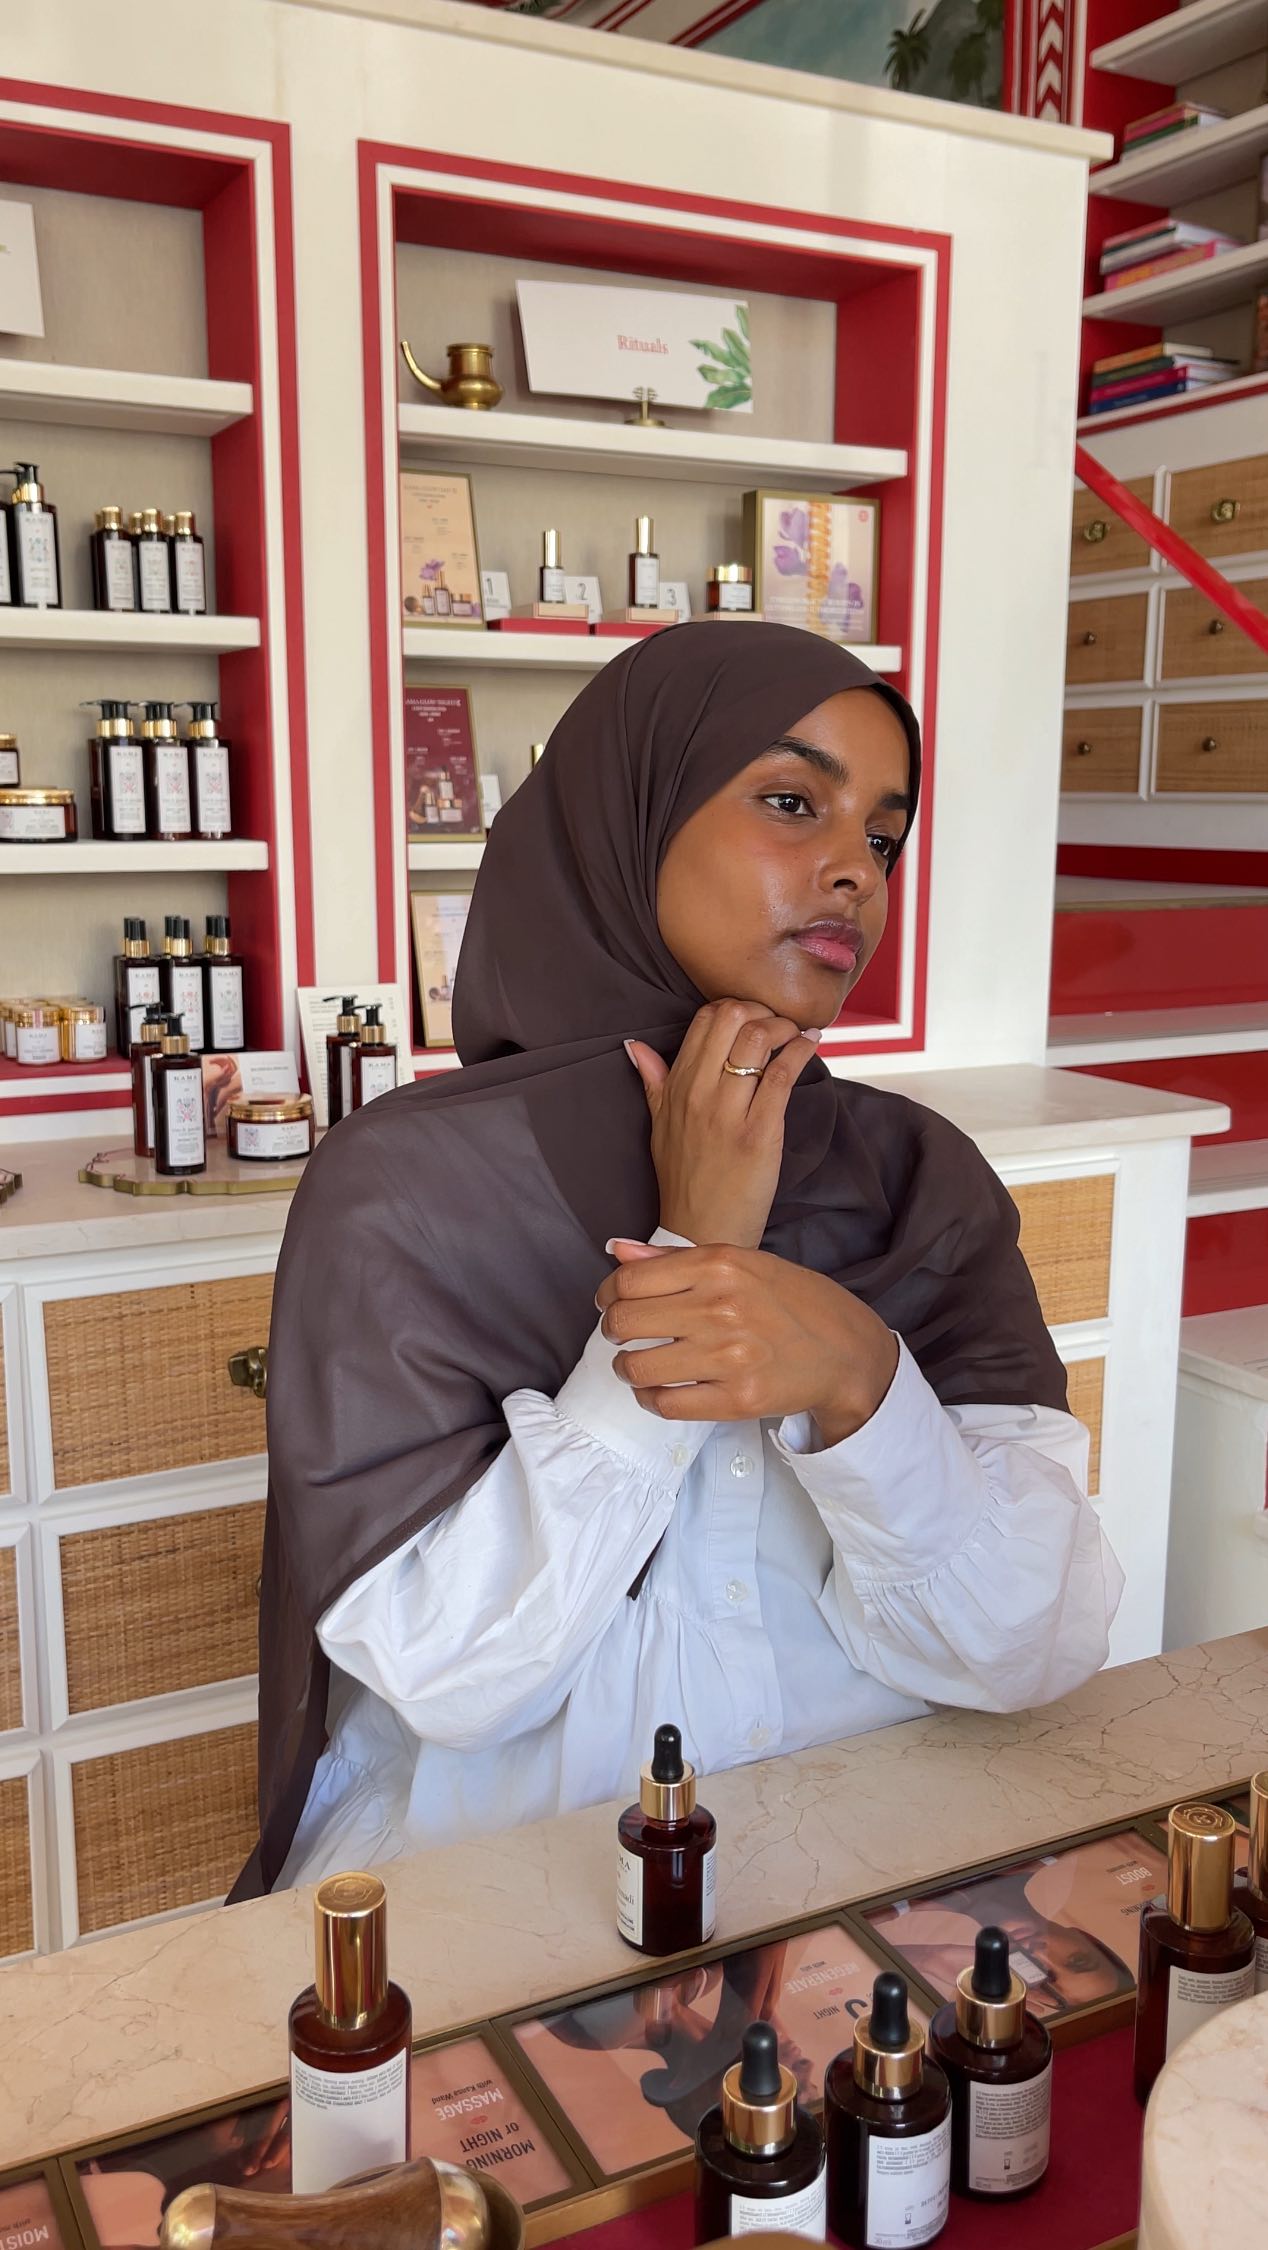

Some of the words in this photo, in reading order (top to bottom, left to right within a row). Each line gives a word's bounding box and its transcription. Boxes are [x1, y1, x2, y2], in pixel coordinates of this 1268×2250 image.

[617, 334, 669, 354] Rituals
[577, 582, 588, 600] 2
[666, 588, 678, 606] 3
[1116, 1867, 1152, 1885] BOOST
[784, 1961, 860, 1994] REGENERATE
[812, 2006, 840, 2020] NIGHT
[476, 2080, 493, 2091] with
[431, 2092, 454, 2105] Wand
[434, 2087, 504, 2121] MASSAGE
[505, 2122, 519, 2135] or
[459, 2128, 504, 2153] NIGHT
[465, 2139, 535, 2170] MORNING
